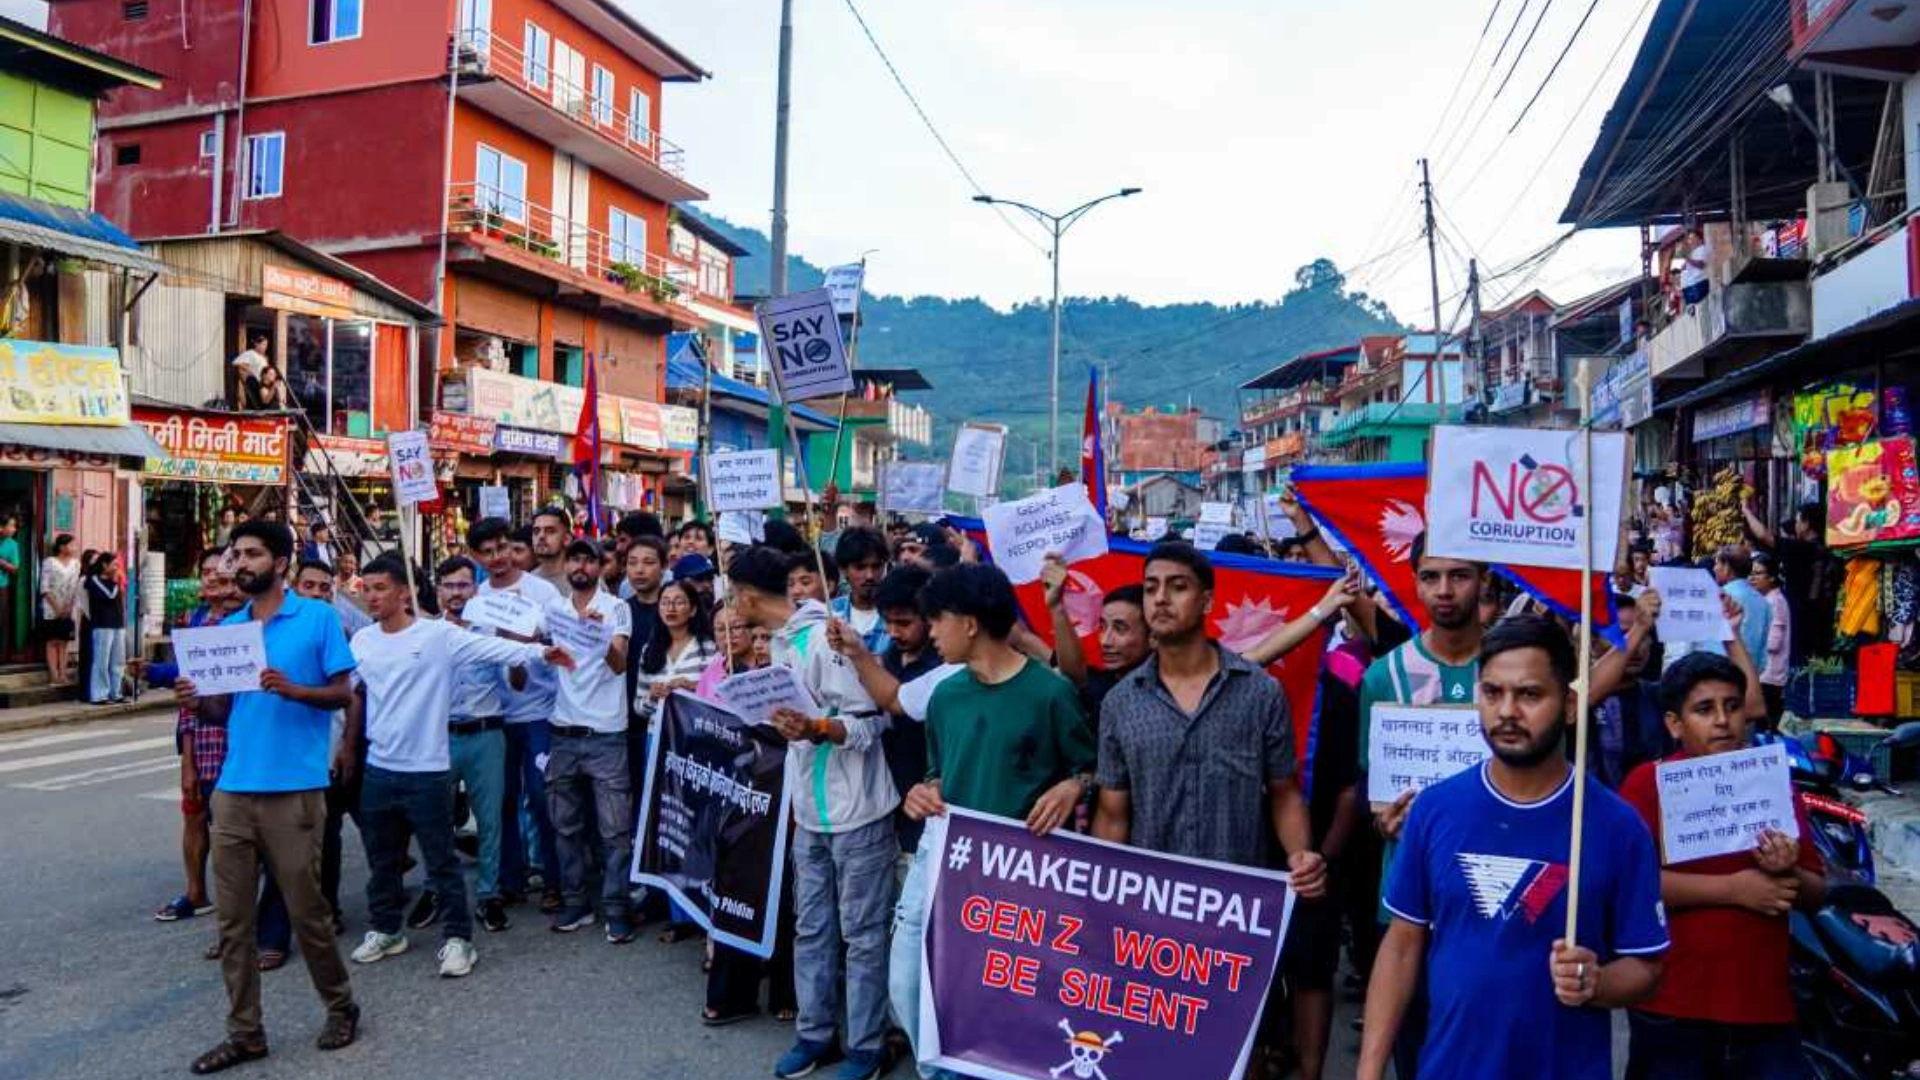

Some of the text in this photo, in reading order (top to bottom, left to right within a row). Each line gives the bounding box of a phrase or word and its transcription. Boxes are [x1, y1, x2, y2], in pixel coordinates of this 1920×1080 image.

[773, 315, 825, 342] SAY
[187, 417, 240, 453] मिनी
[241, 426, 284, 456] मार्ट
[397, 446, 421, 462] SAY
[1470, 521, 1576, 541] CORRUPTION
[982, 843, 1272, 937] WAKEUPNEPAL
[960, 895, 1253, 993] GEN Z WON'T
[982, 951, 1209, 1035] BE SILENT
